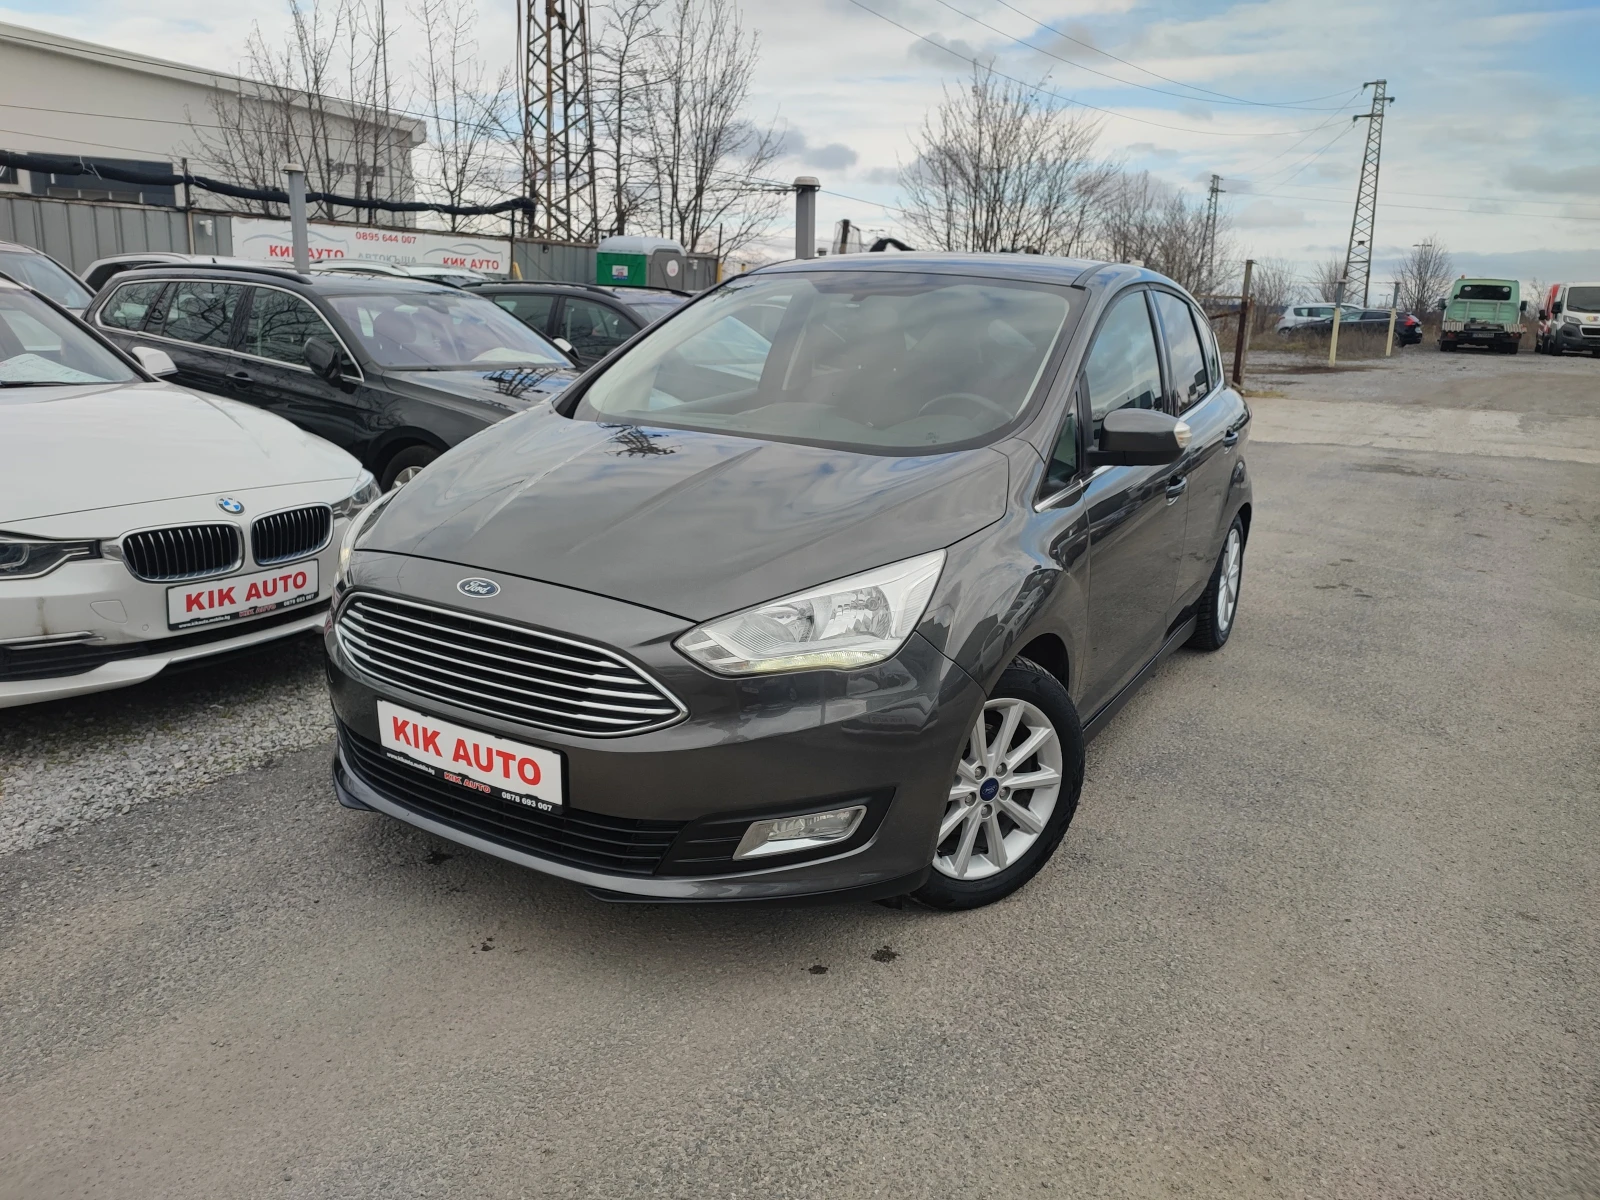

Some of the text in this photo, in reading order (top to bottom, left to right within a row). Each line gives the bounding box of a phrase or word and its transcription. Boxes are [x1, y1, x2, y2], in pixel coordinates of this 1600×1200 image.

[355, 231, 417, 244] 0895 644 007
[269, 245, 295, 258] КИ
[443, 256, 499, 270] КИК АУТО
[185, 571, 307, 613] KIK AUTO
[464, 580, 491, 594] Ford
[392, 715, 542, 786] KIK AUTO
[443, 771, 492, 794] KIK AUTO
[501, 791, 553, 812] 0878 693 007
